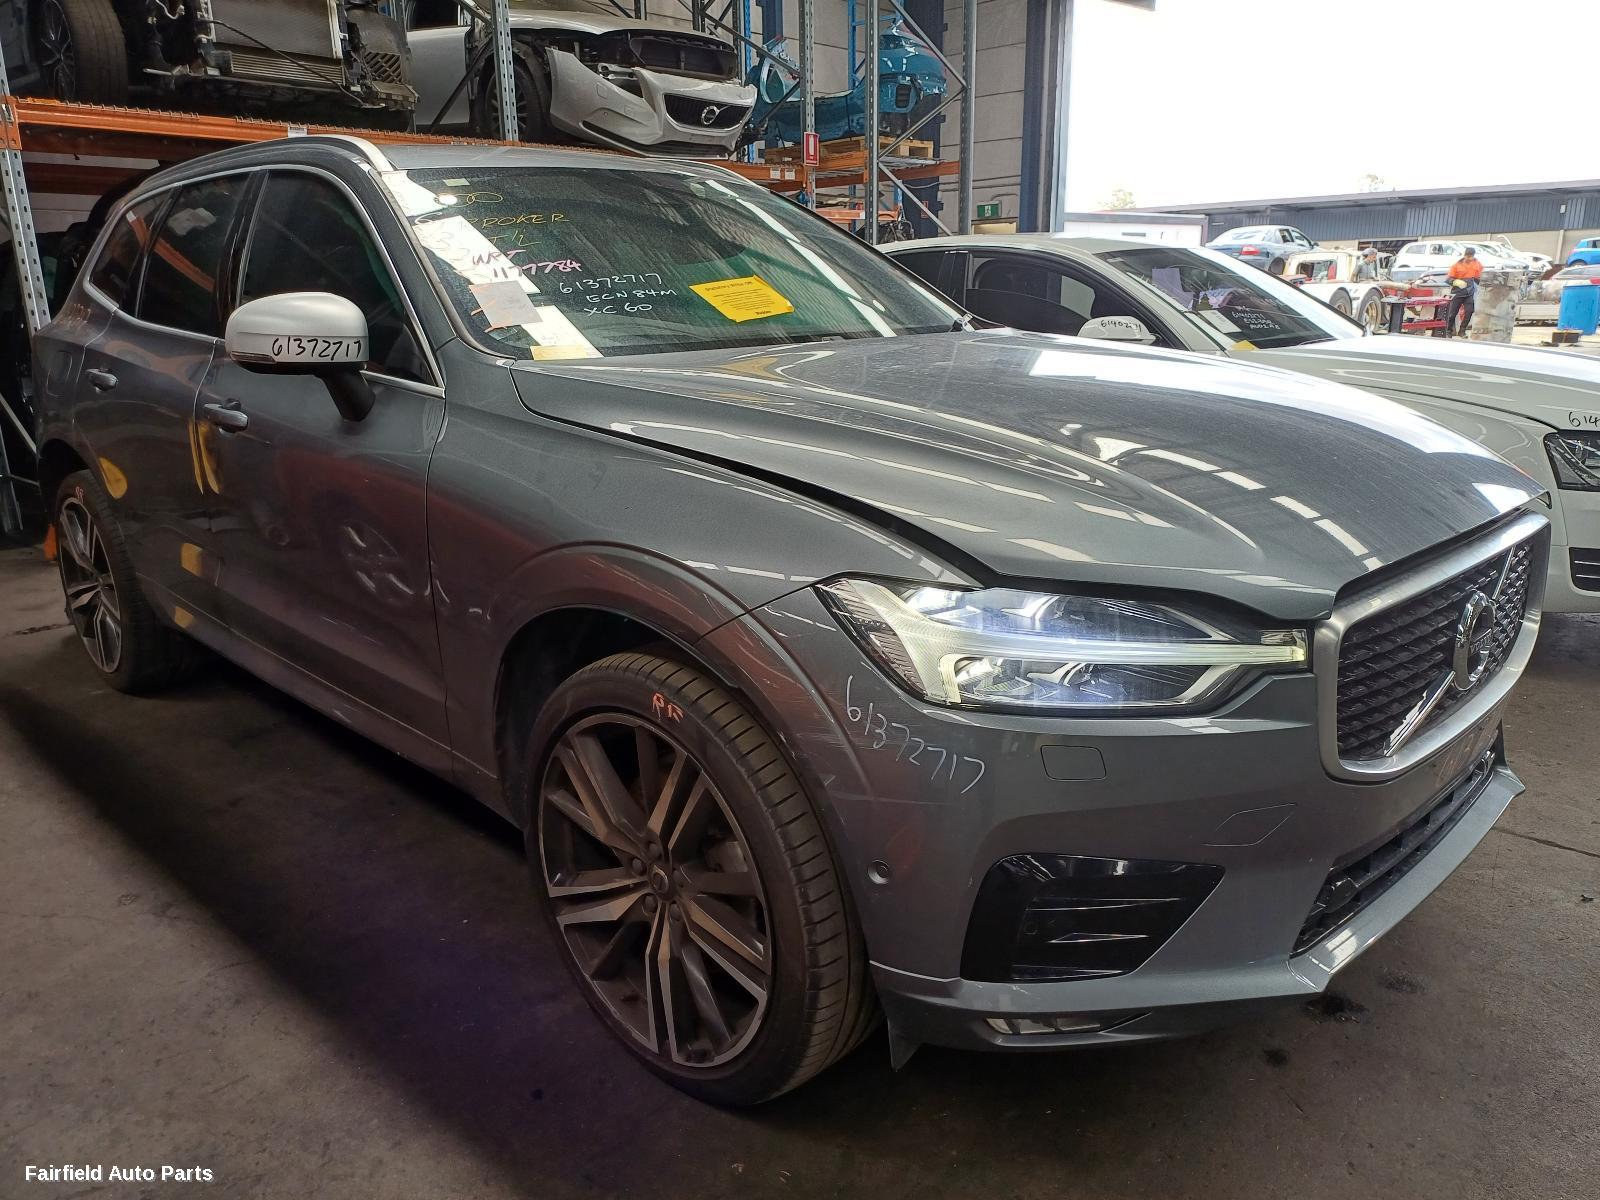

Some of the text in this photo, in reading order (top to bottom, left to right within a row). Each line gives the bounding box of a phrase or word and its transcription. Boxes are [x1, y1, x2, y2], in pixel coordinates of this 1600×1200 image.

[559, 273, 662, 294] 61372717
[586, 288, 678, 303] ECN 84M
[584, 302, 653, 317] XC 60
[271, 336, 362, 361] 61372717
[846, 674, 986, 794] 61372717
